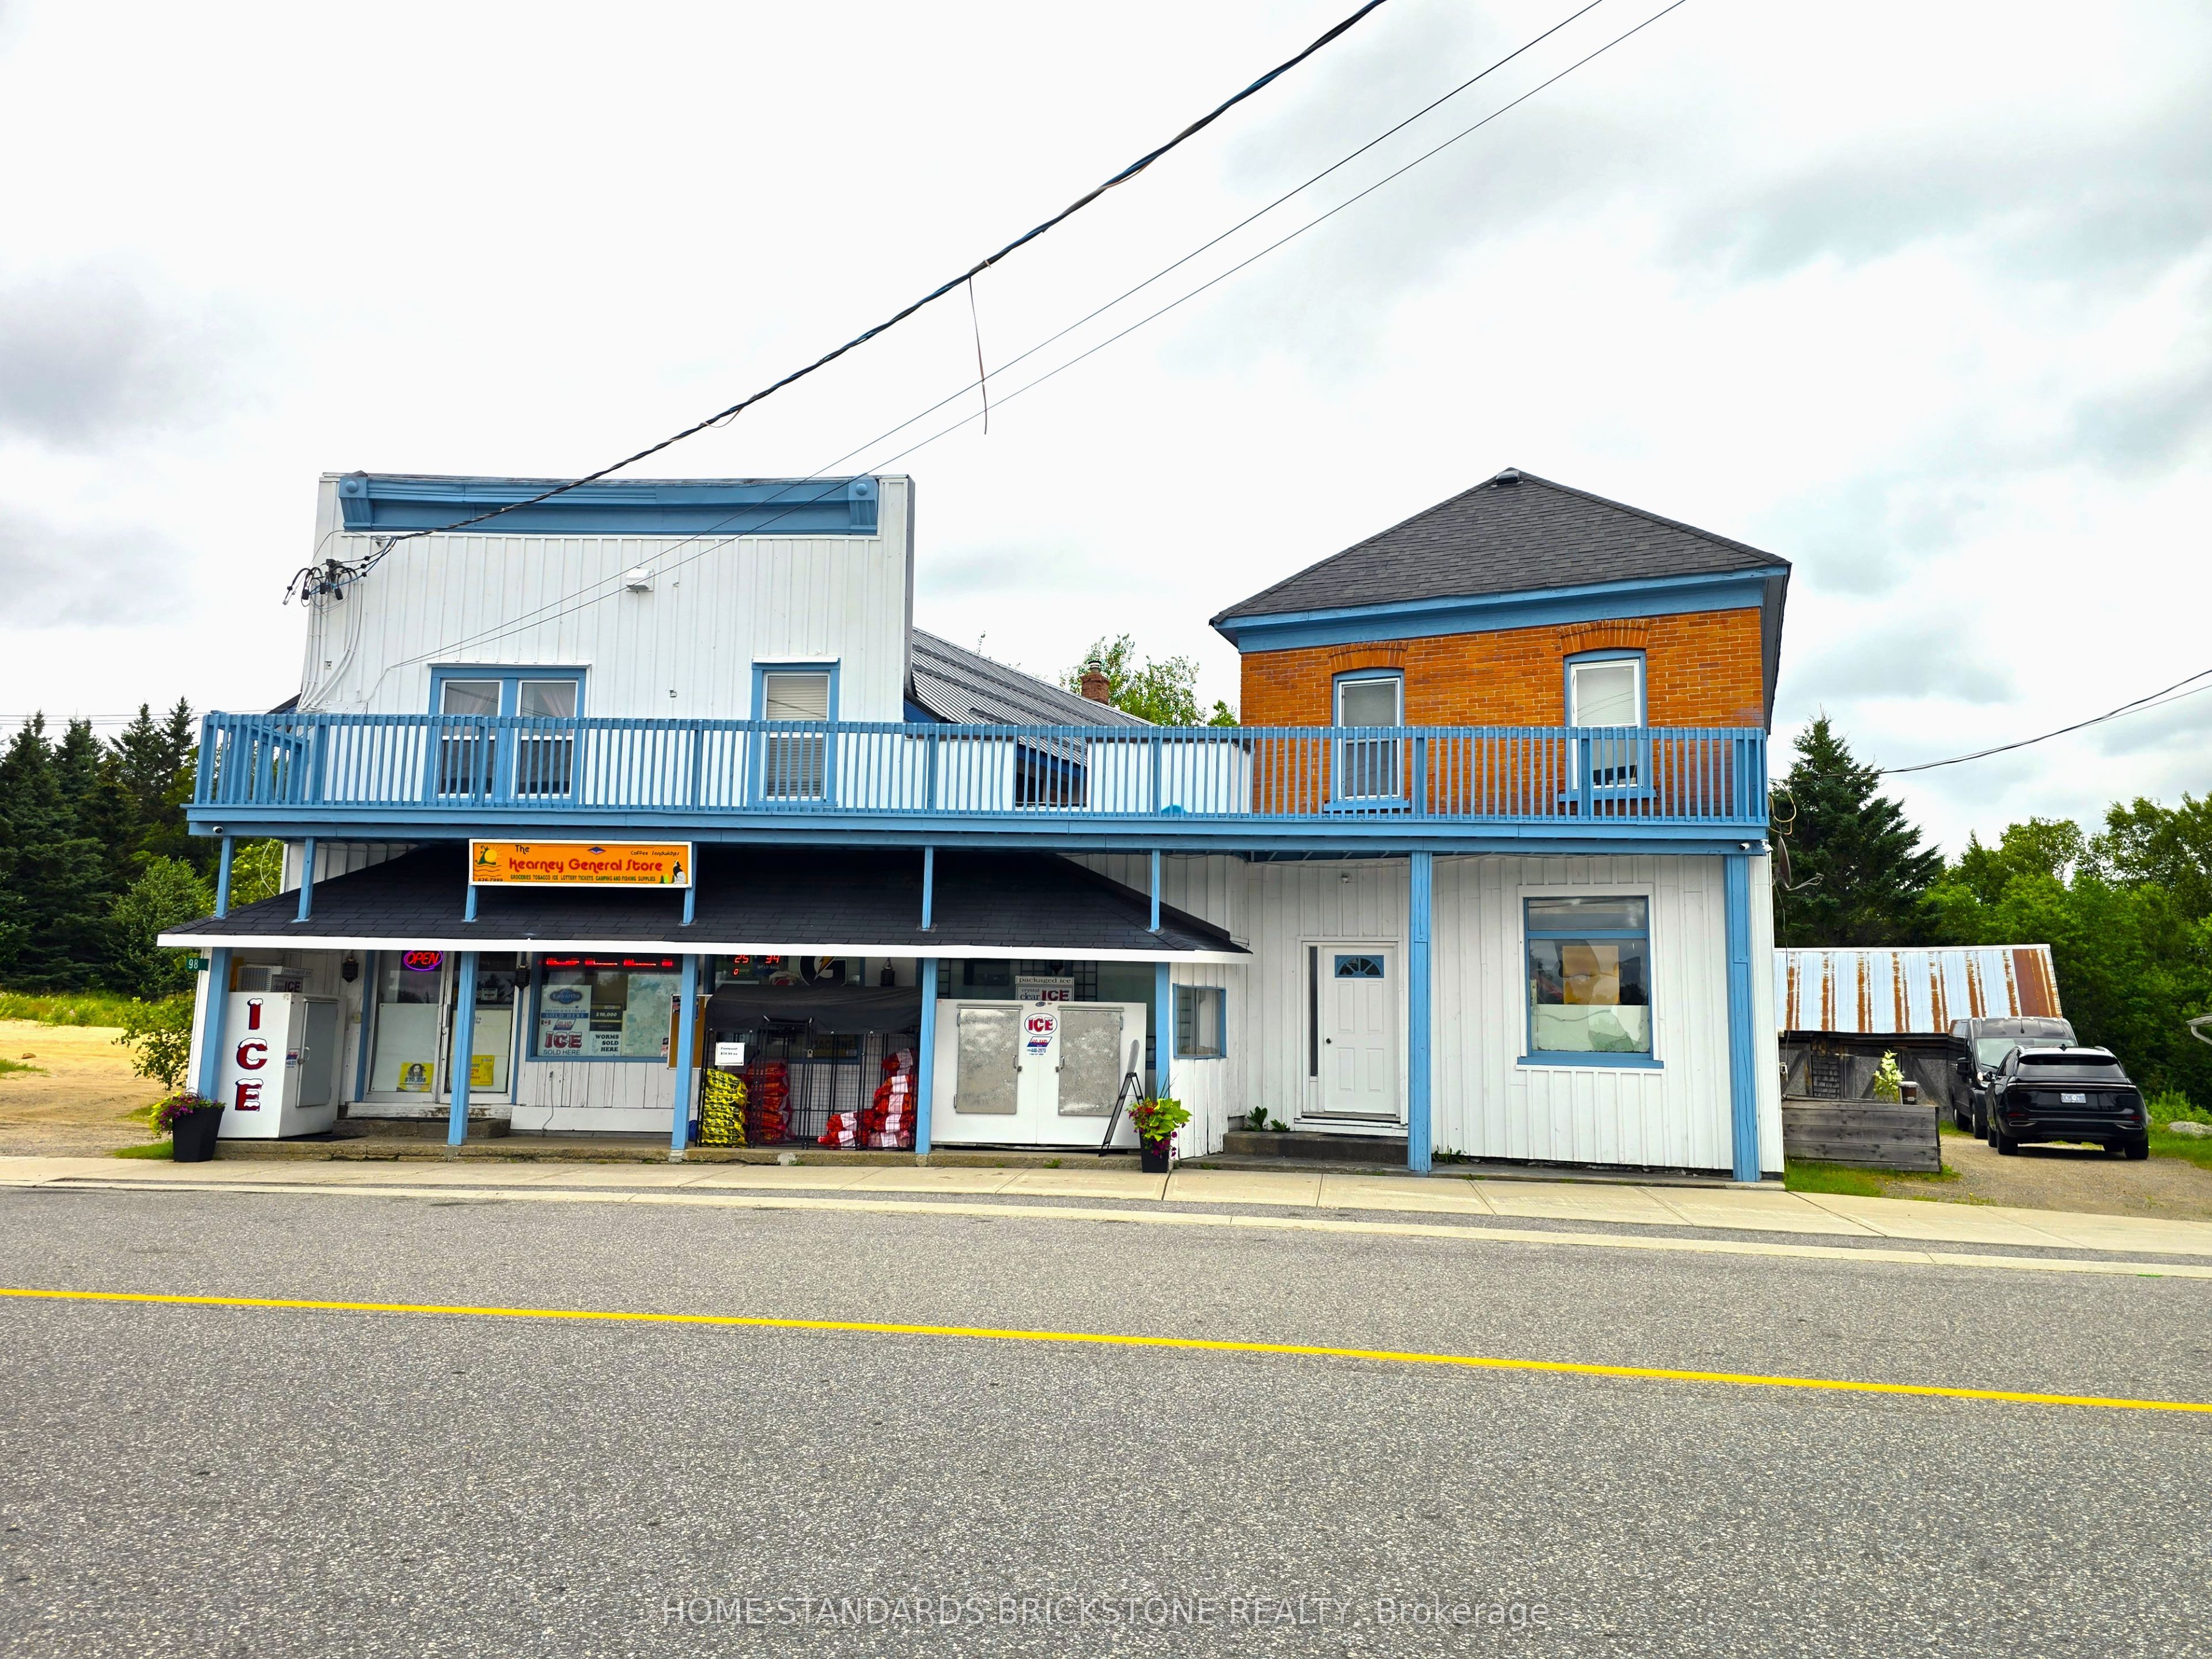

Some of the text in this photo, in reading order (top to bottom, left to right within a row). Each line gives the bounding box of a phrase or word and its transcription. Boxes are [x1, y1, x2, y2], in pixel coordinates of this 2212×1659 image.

[515, 845, 529, 854] The
[509, 857, 662, 874] Kearney General Store
[188, 959, 199, 969] 98
[406, 952, 440, 965] OPEN
[285, 980, 301, 993] ICE
[1020, 989, 1070, 1001] clear ICE
[1028, 1016, 1054, 1032] ICE
[544, 1031, 582, 1048] ICE
[235, 998, 268, 1112] ICE
